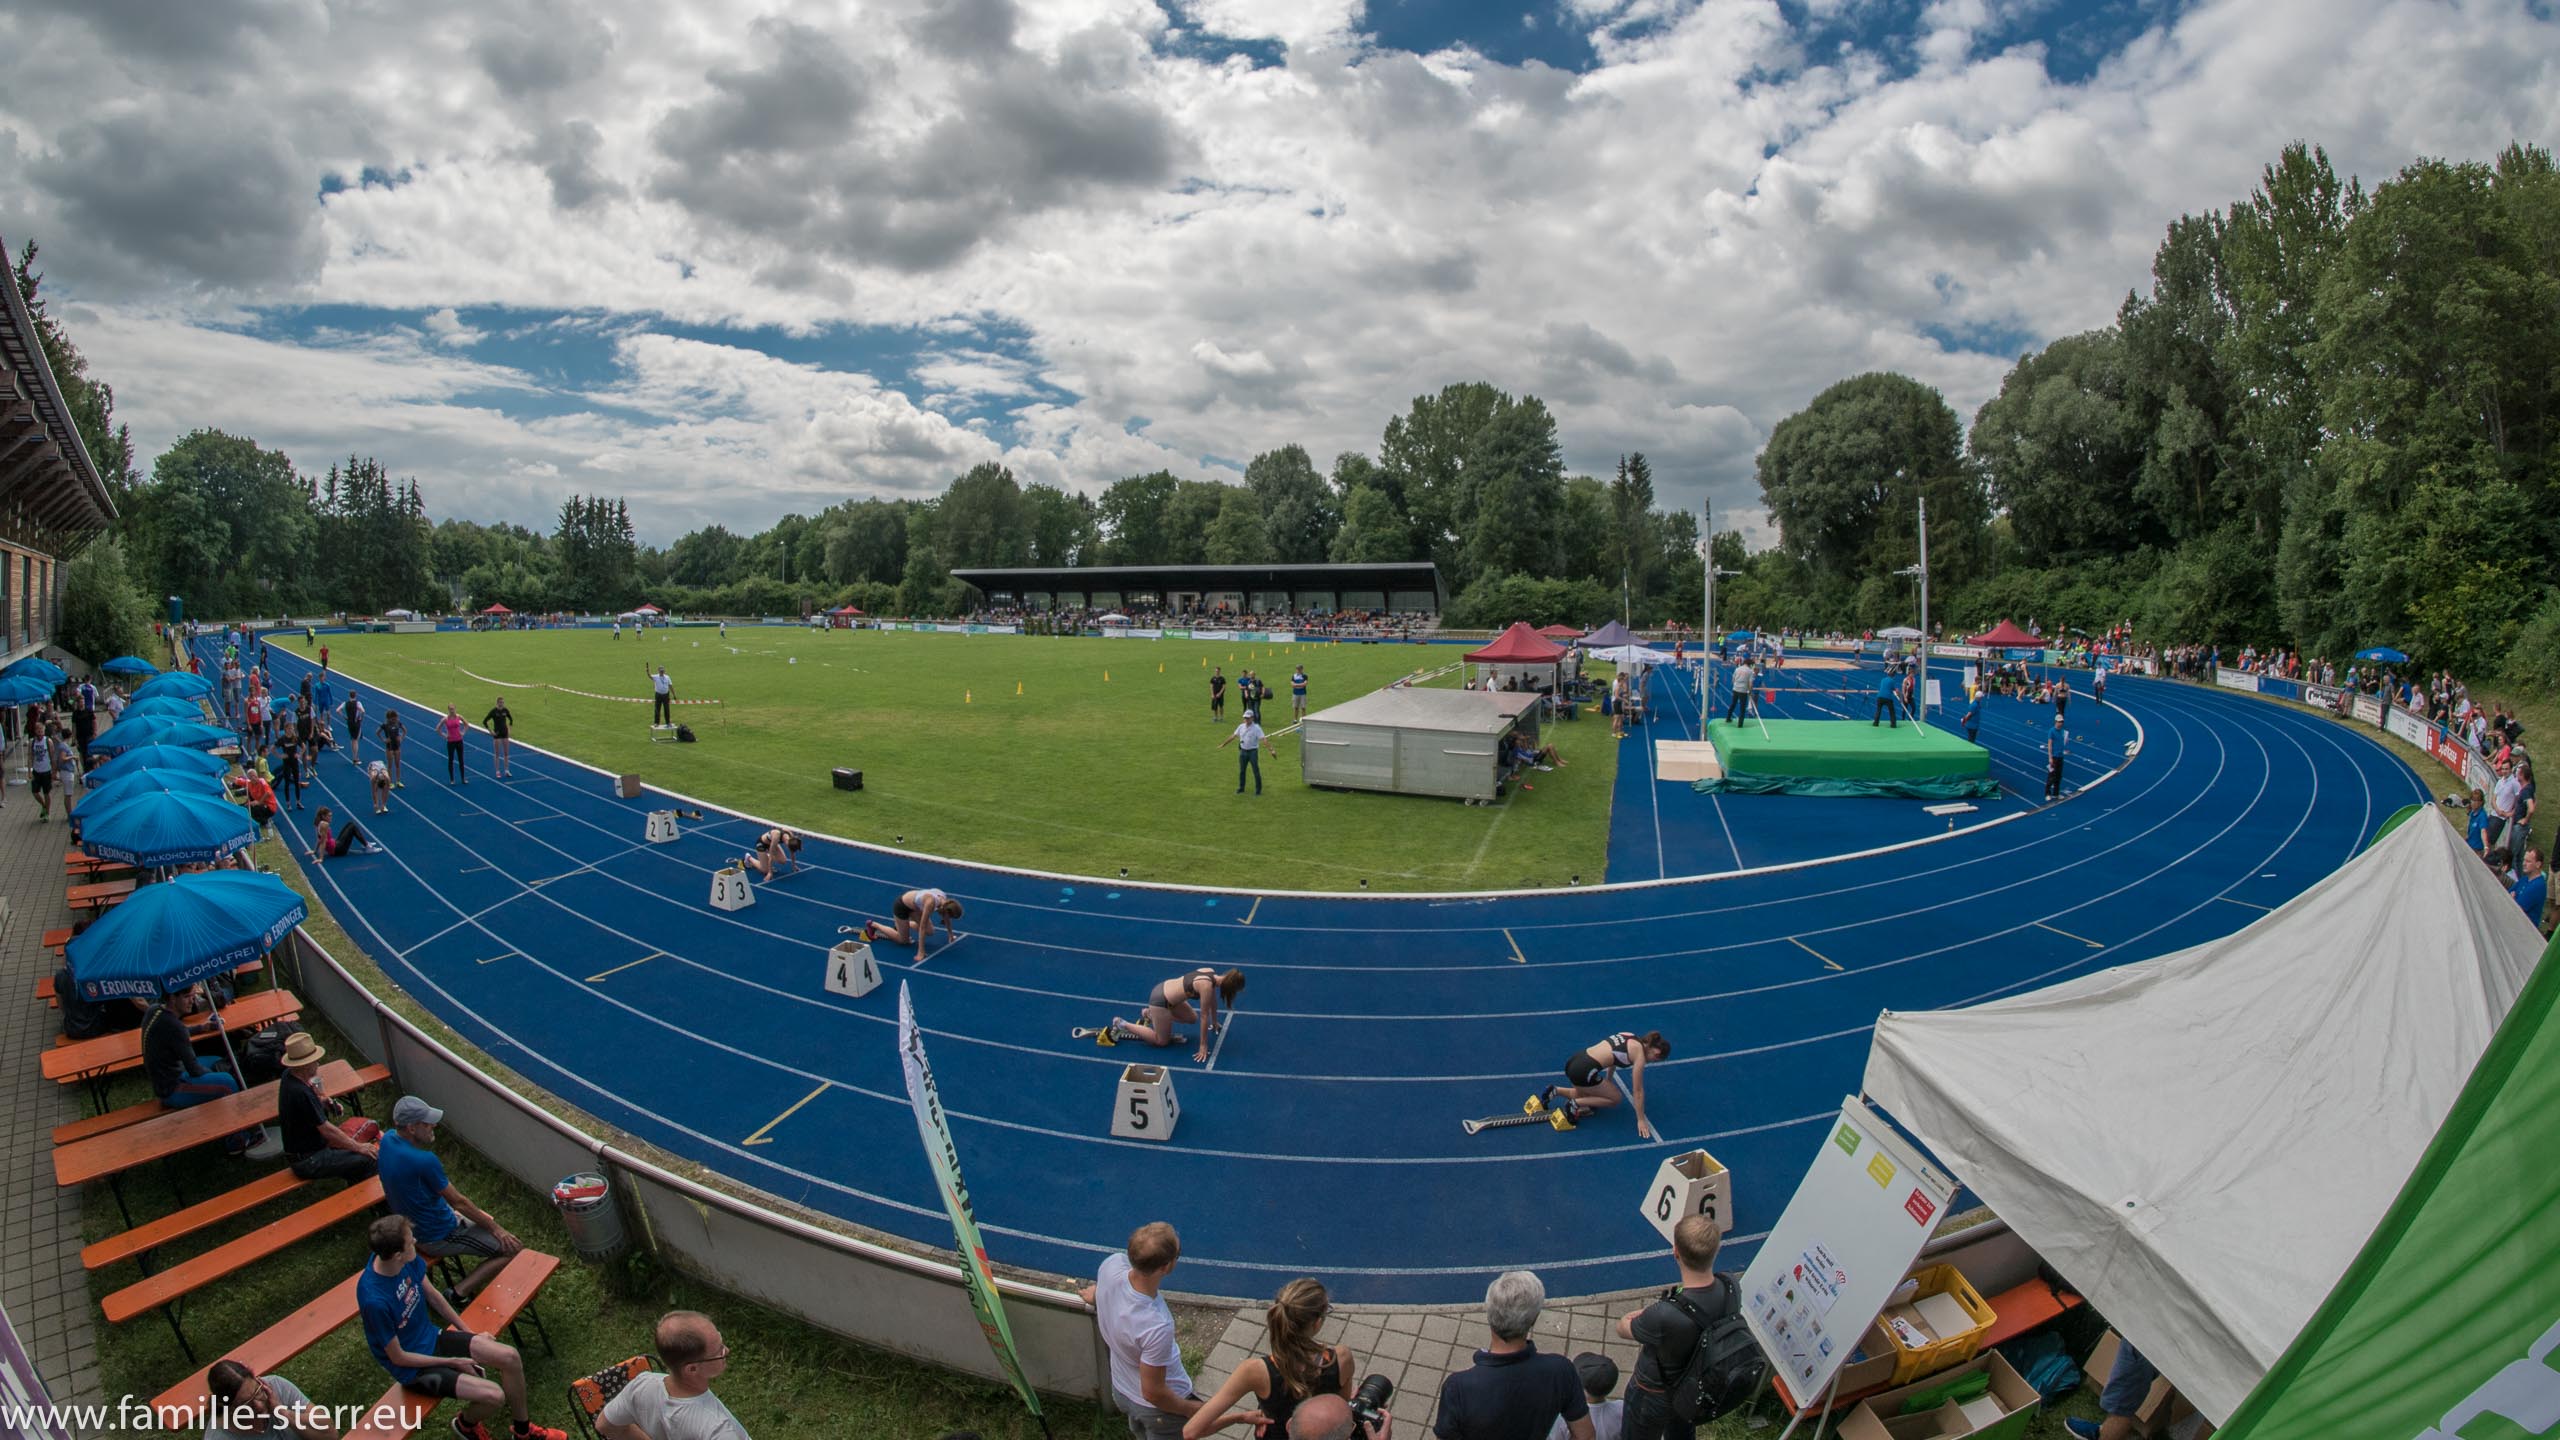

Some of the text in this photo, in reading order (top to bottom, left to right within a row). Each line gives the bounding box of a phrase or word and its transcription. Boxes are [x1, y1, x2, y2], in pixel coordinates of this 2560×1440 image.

[651, 820, 656, 838] 2
[664, 820, 674, 837] 2
[228, 831, 257, 850] ERDINGER
[98, 844, 137, 865] ERDINGER
[145, 850, 213, 864] ALKOHOLFREI
[717, 882, 725, 902] 3
[735, 881, 746, 901] 3
[271, 905, 304, 940] ERDINGER
[168, 945, 256, 987] ALKOHOLFREI
[837, 963, 848, 988] 4
[864, 959, 873, 983] 4
[100, 979, 157, 996] ERDINGER
[1130, 1097, 1149, 1130] 5
[1165, 1086, 1175, 1119] 5
[1657, 1184, 1676, 1222] 6
[1698, 1193, 1717, 1221] 6
